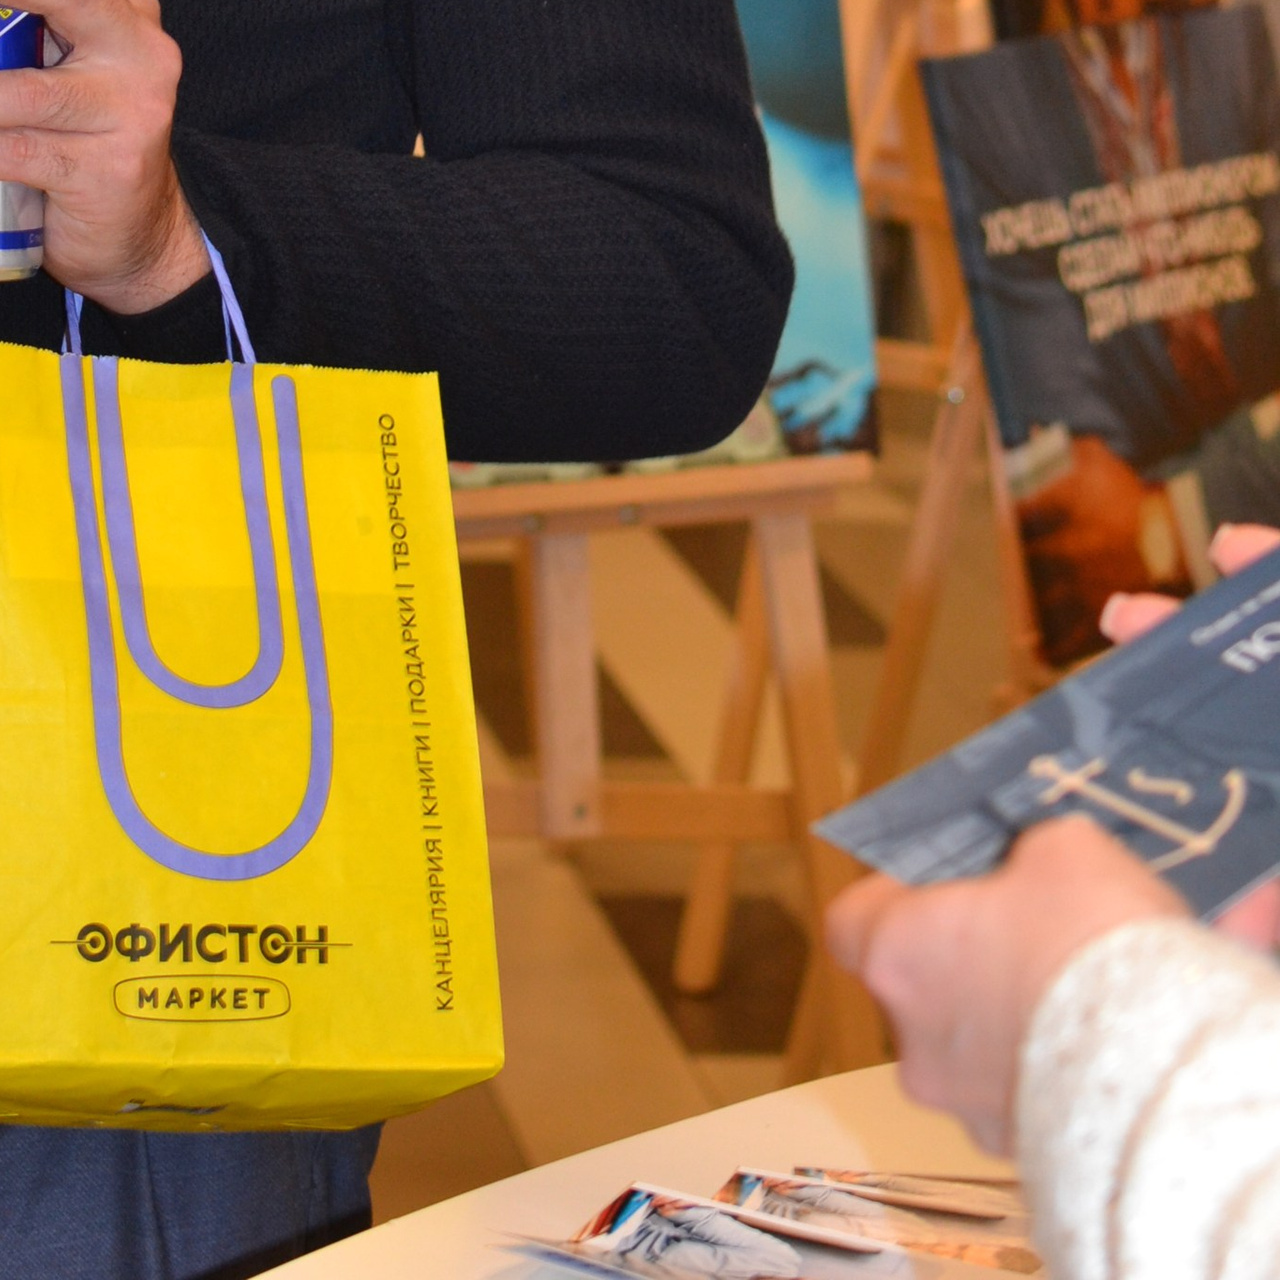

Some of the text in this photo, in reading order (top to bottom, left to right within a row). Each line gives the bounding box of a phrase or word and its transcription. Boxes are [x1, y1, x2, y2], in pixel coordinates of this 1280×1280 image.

[378, 412, 455, 1013] КАНЦЕЛЯРИЯ КНИГИ ПОДАРКИ ТВОРЧЕСТВО
[76, 922, 329, 964] ОФИСТОН
[137, 986, 271, 1010] МАРКЕТ
